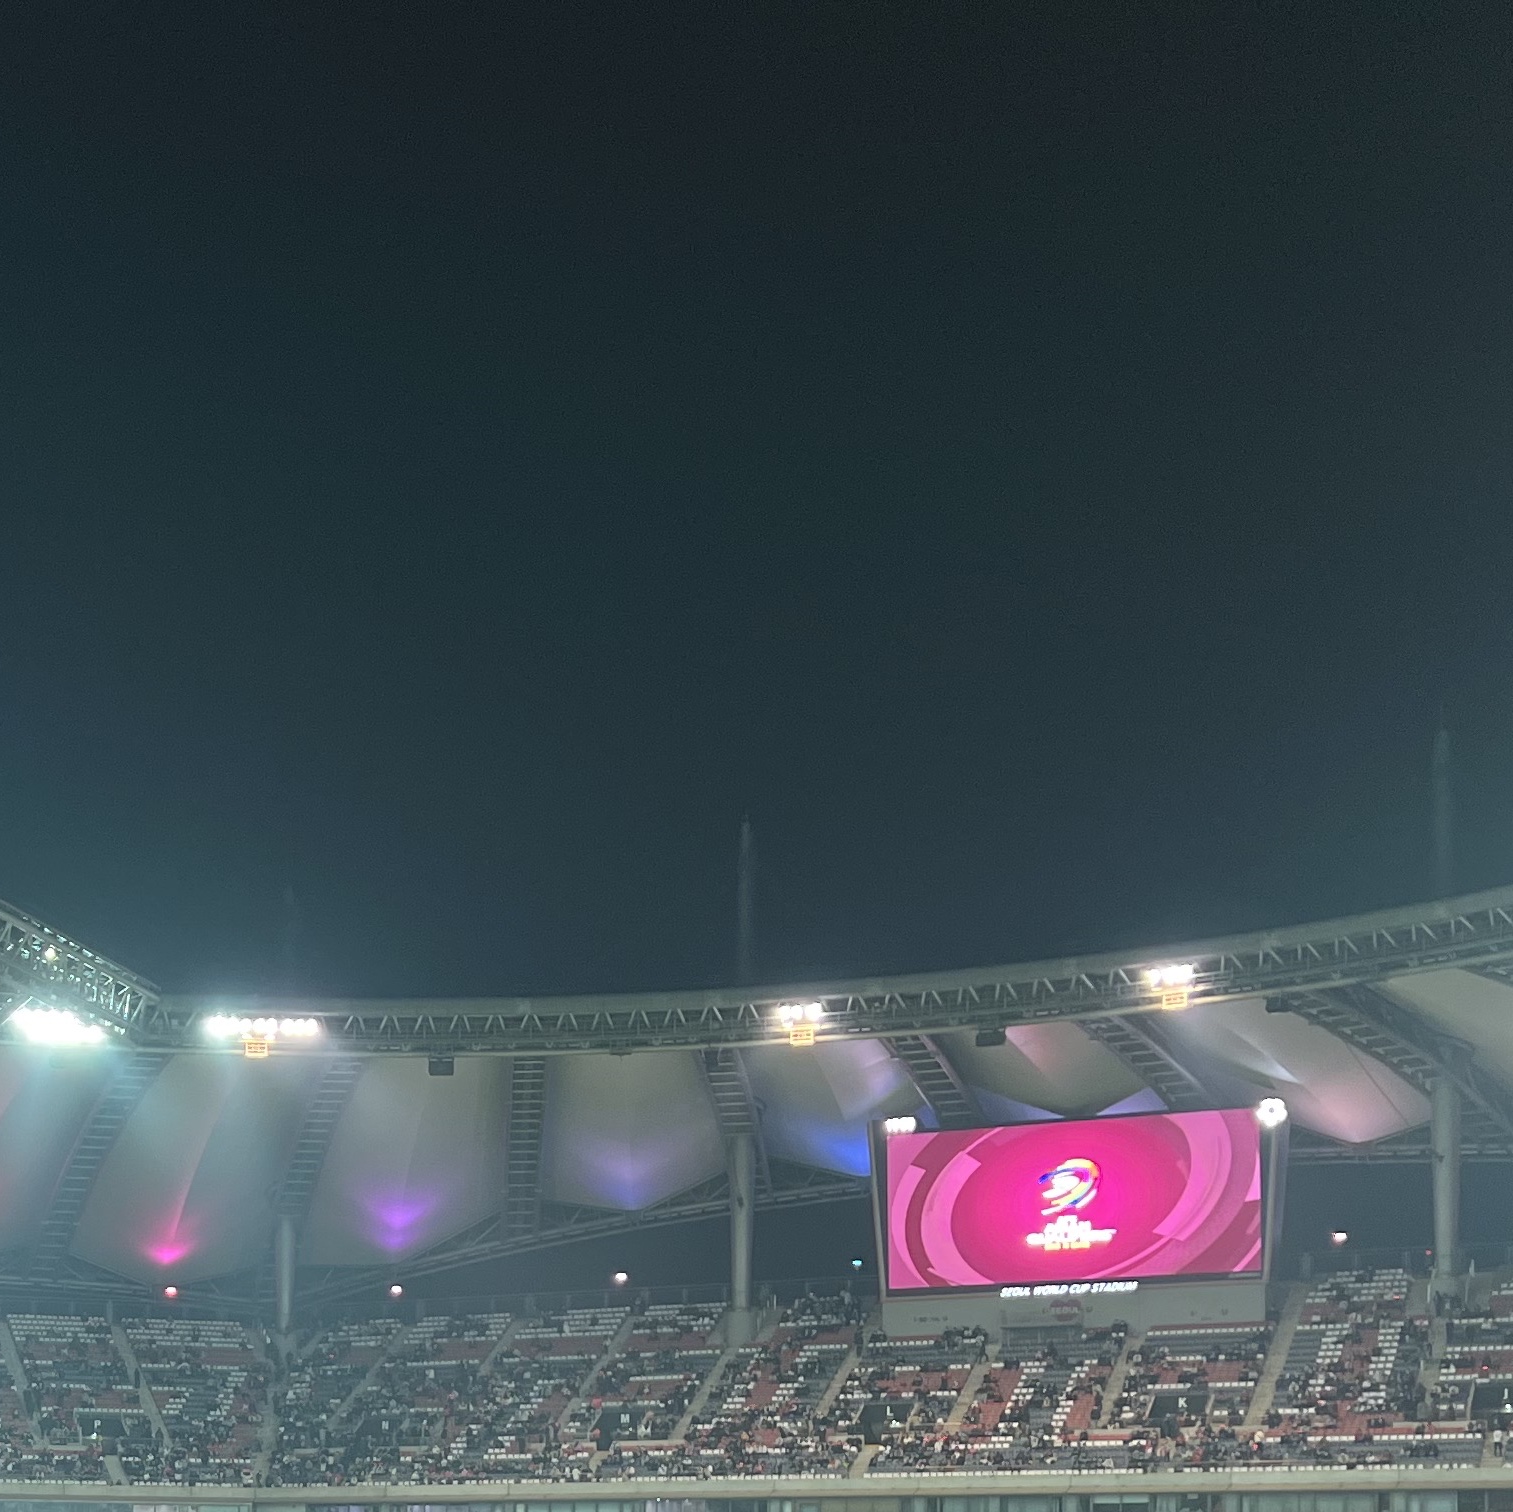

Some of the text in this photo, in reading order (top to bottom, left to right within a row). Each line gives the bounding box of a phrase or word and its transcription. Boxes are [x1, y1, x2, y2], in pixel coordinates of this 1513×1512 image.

[1000, 1281, 1138, 1298] SEOUL WORLD CUP STADIUM
[1178, 1396, 1188, 1408] K
[886, 1405, 894, 1417] L
[620, 1414, 630, 1424] M
